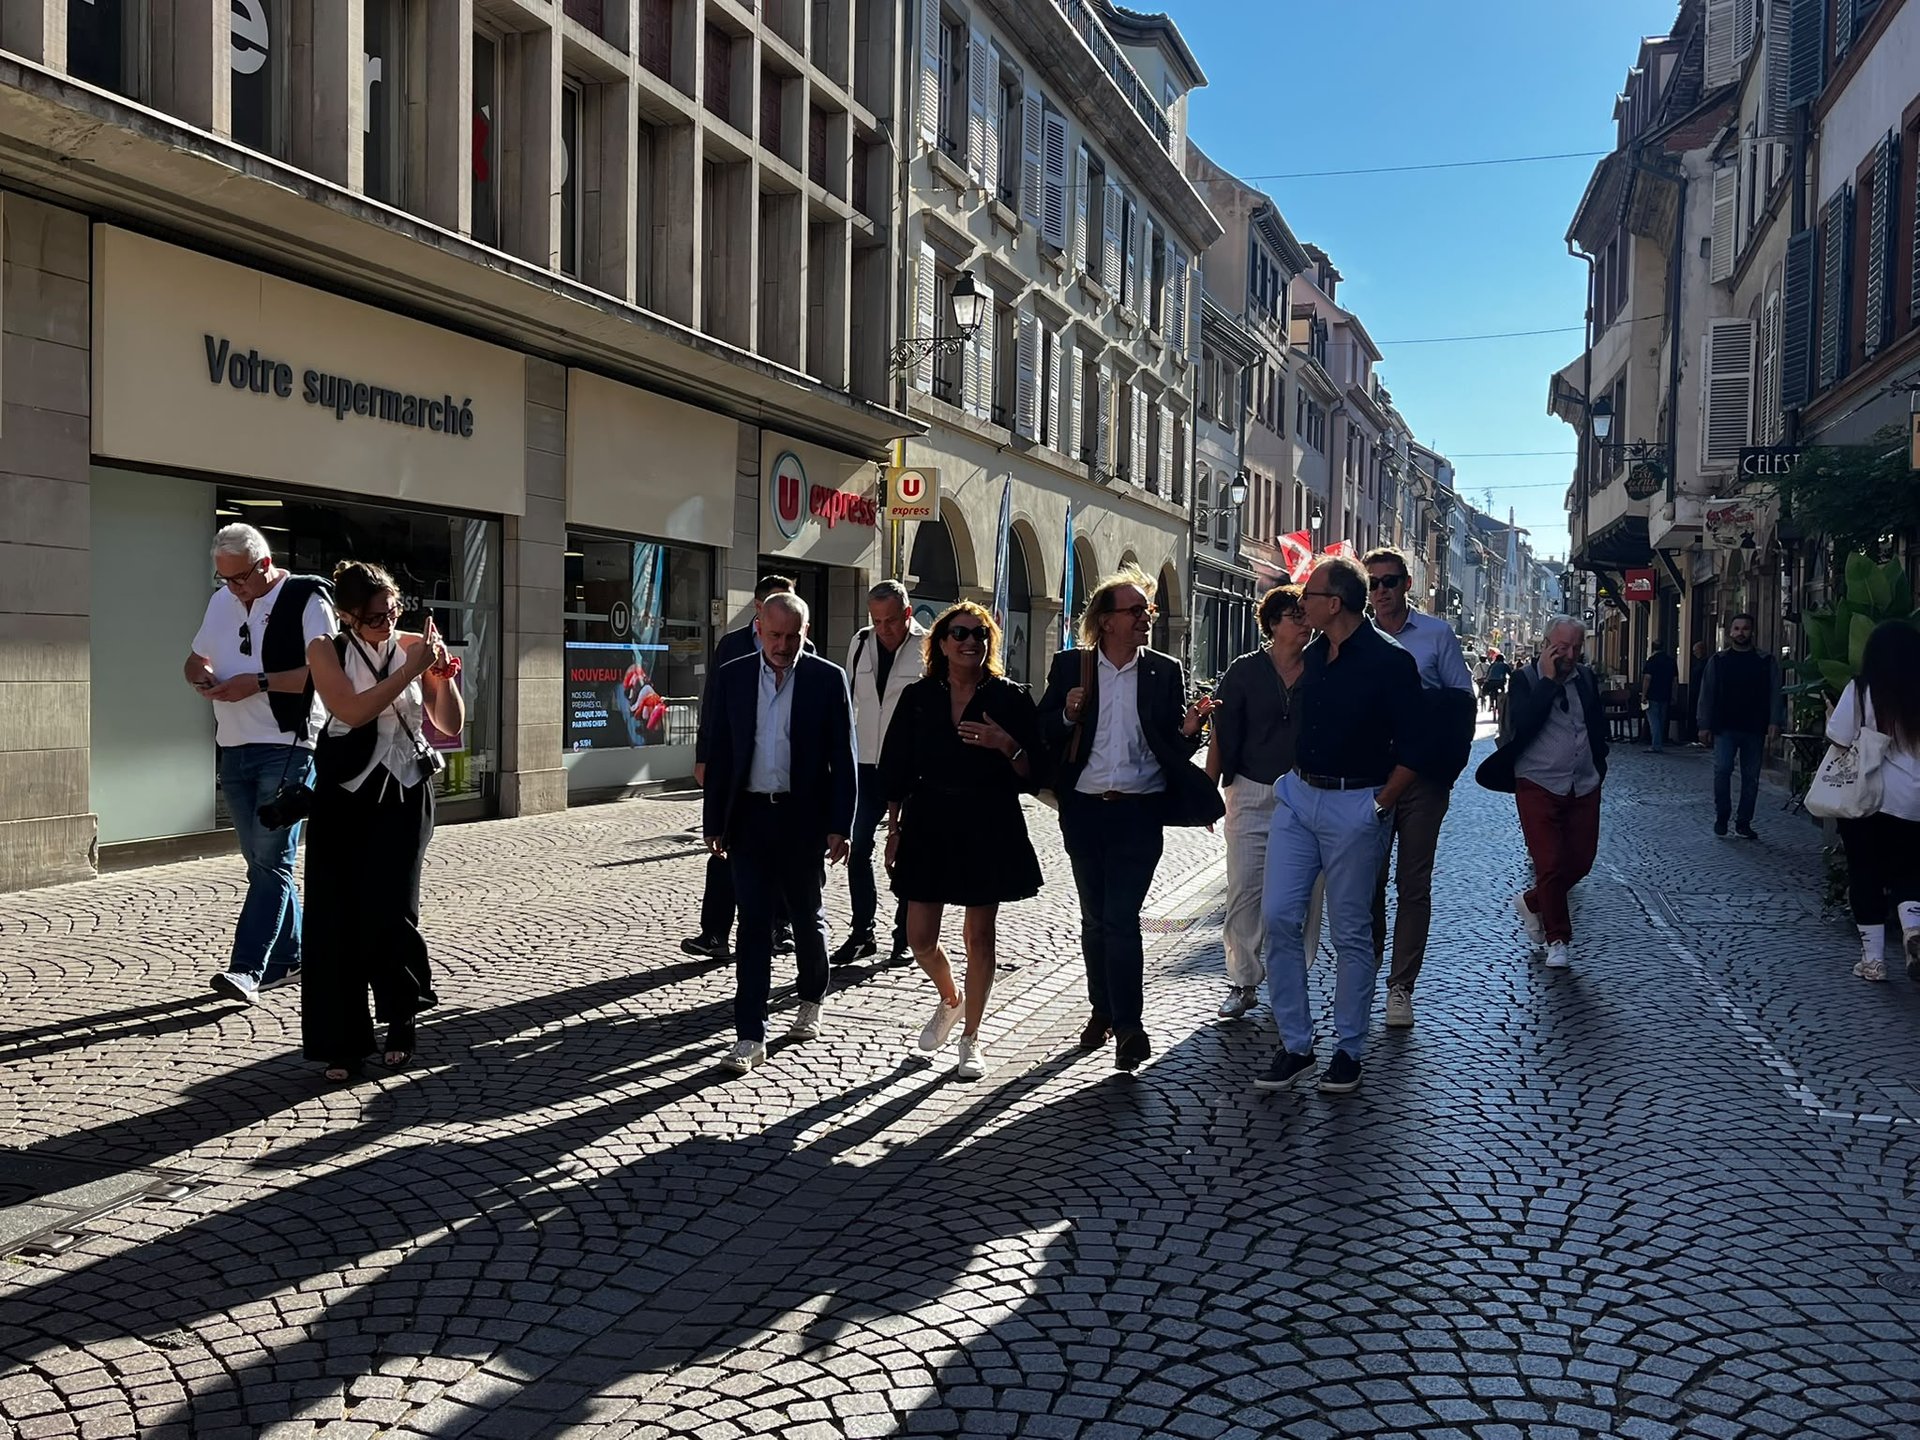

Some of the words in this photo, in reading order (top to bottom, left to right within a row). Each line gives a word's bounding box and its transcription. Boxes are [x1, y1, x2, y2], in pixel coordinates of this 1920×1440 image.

[203, 334, 293, 398] Votre
[302, 368, 474, 438] supermarché
[903, 479, 920, 497] U
[778, 475, 800, 521] U
[809, 484, 877, 529] express
[891, 506, 930, 517] express
[615, 610, 625, 629] U
[570, 668, 617, 682] NOUVEAU
[571, 691, 582, 699] NOS
[574, 710, 595, 719] CHAQUE
[592, 719, 607, 728] CHEFS
